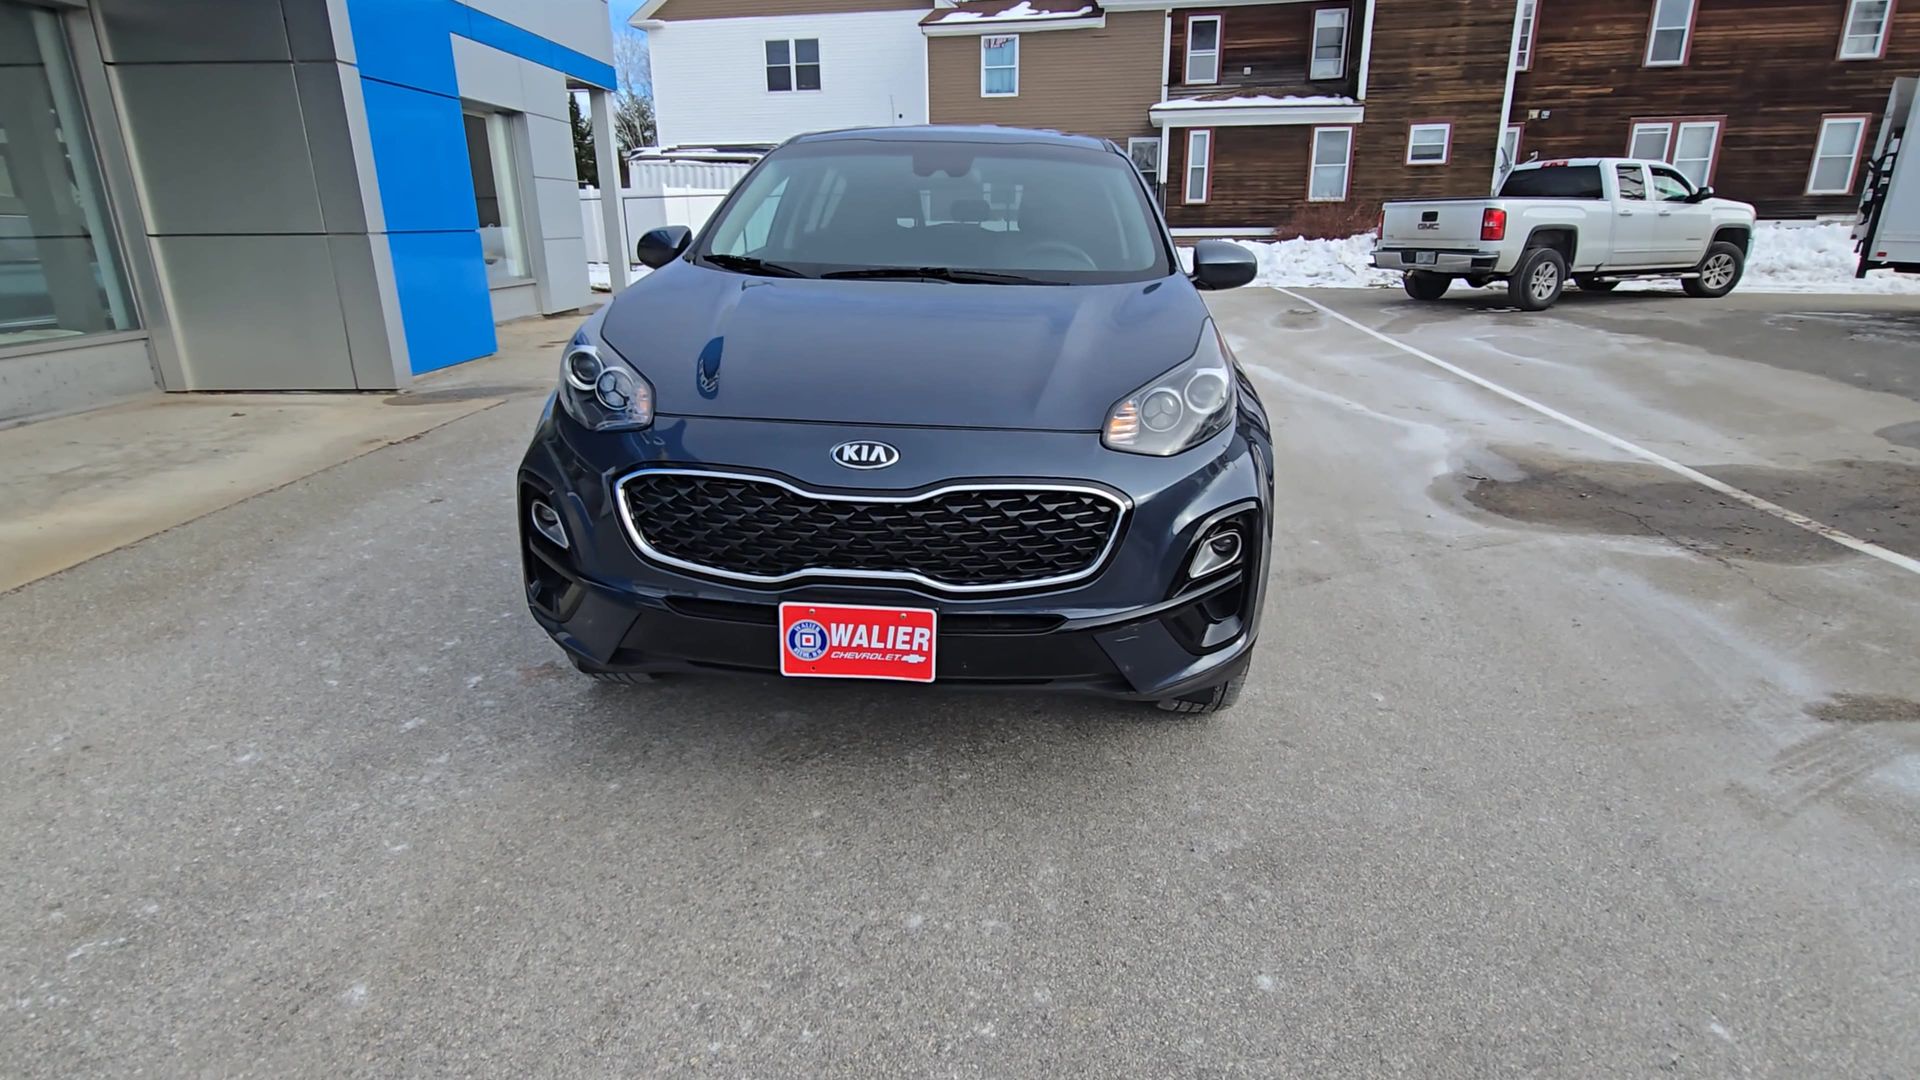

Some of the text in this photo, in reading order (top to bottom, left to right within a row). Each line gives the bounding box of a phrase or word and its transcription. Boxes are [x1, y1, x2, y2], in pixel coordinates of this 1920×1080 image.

[842, 445, 887, 462] KIA
[830, 623, 931, 651] WALIER
[830, 651, 902, 661] CHEVROLET
